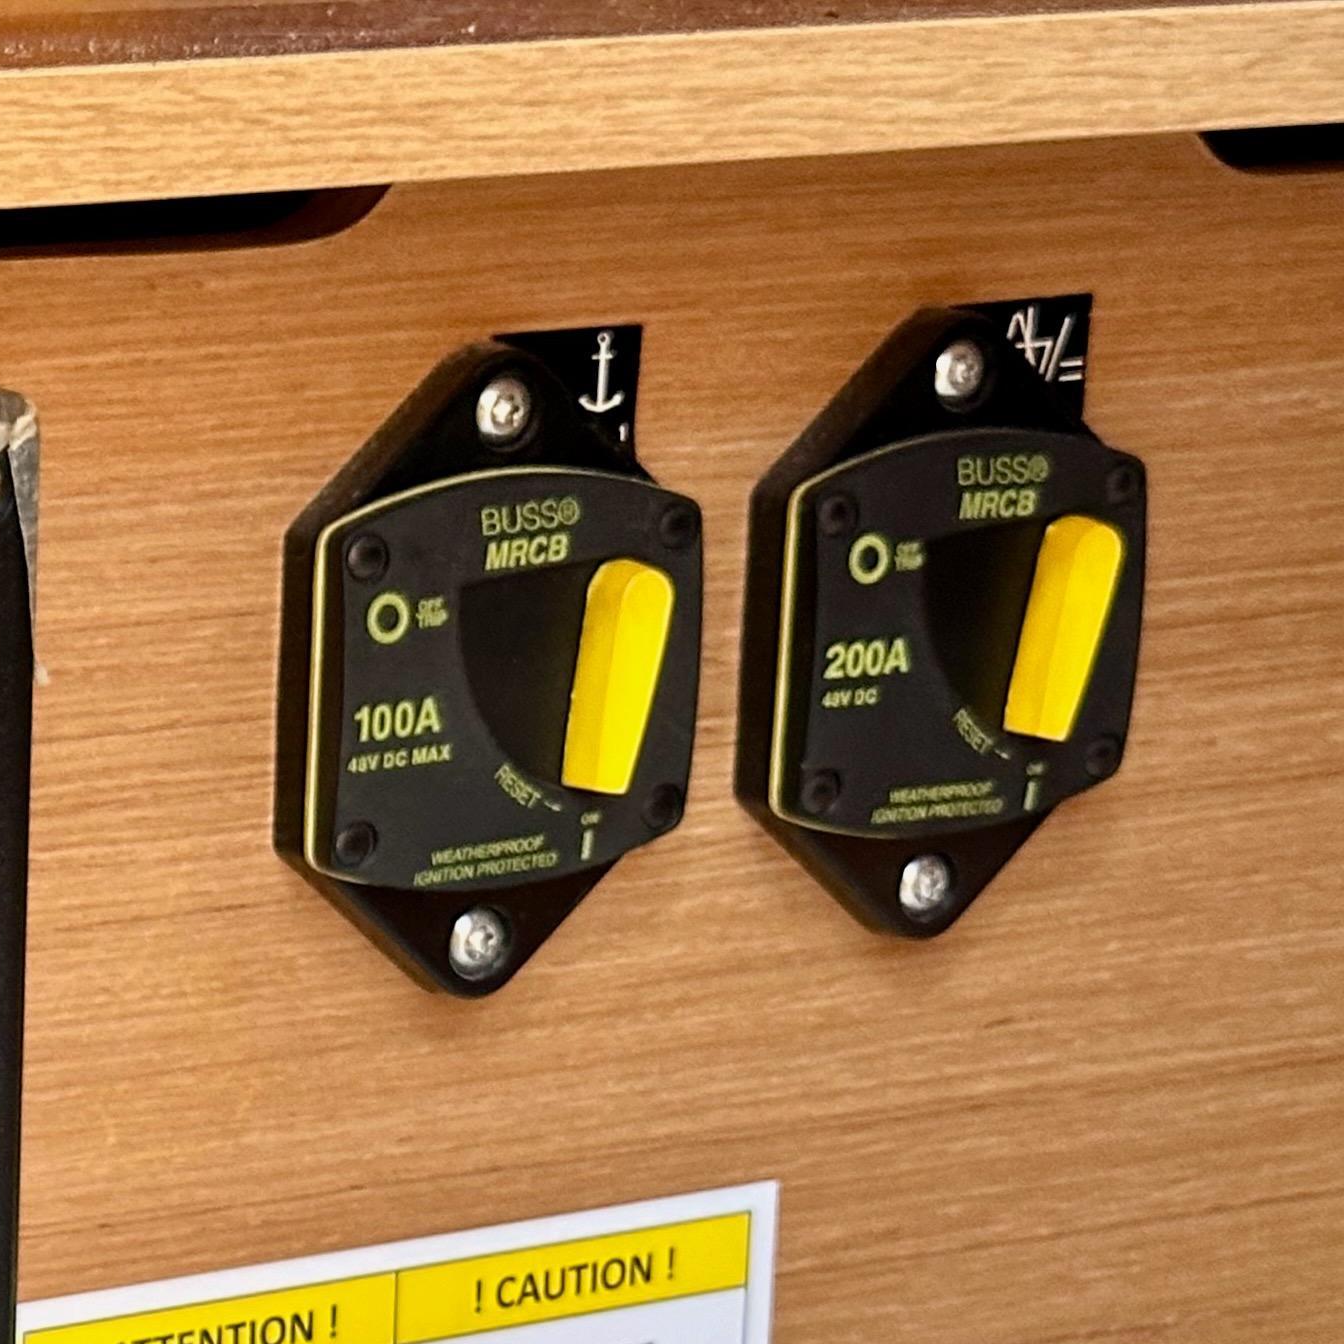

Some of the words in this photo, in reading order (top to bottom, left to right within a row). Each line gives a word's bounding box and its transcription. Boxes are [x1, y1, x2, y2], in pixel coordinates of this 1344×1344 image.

[959, 490, 1036, 519] MRCB
[485, 532, 570, 570] MRCB
[823, 638, 909, 679] 200A
[854, 688, 878, 705] DC
[354, 696, 442, 742] 100A
[347, 755, 382, 773] 48V
[383, 750, 408, 769] DC
[412, 744, 451, 765] MAX
[495, 762, 541, 808] RESET
[431, 835, 544, 865] WEATHERPROOF
[413, 865, 474, 887] IGNITION
[477, 853, 558, 879] PROTECTED
[495, 1252, 653, 1309] CAUTION
